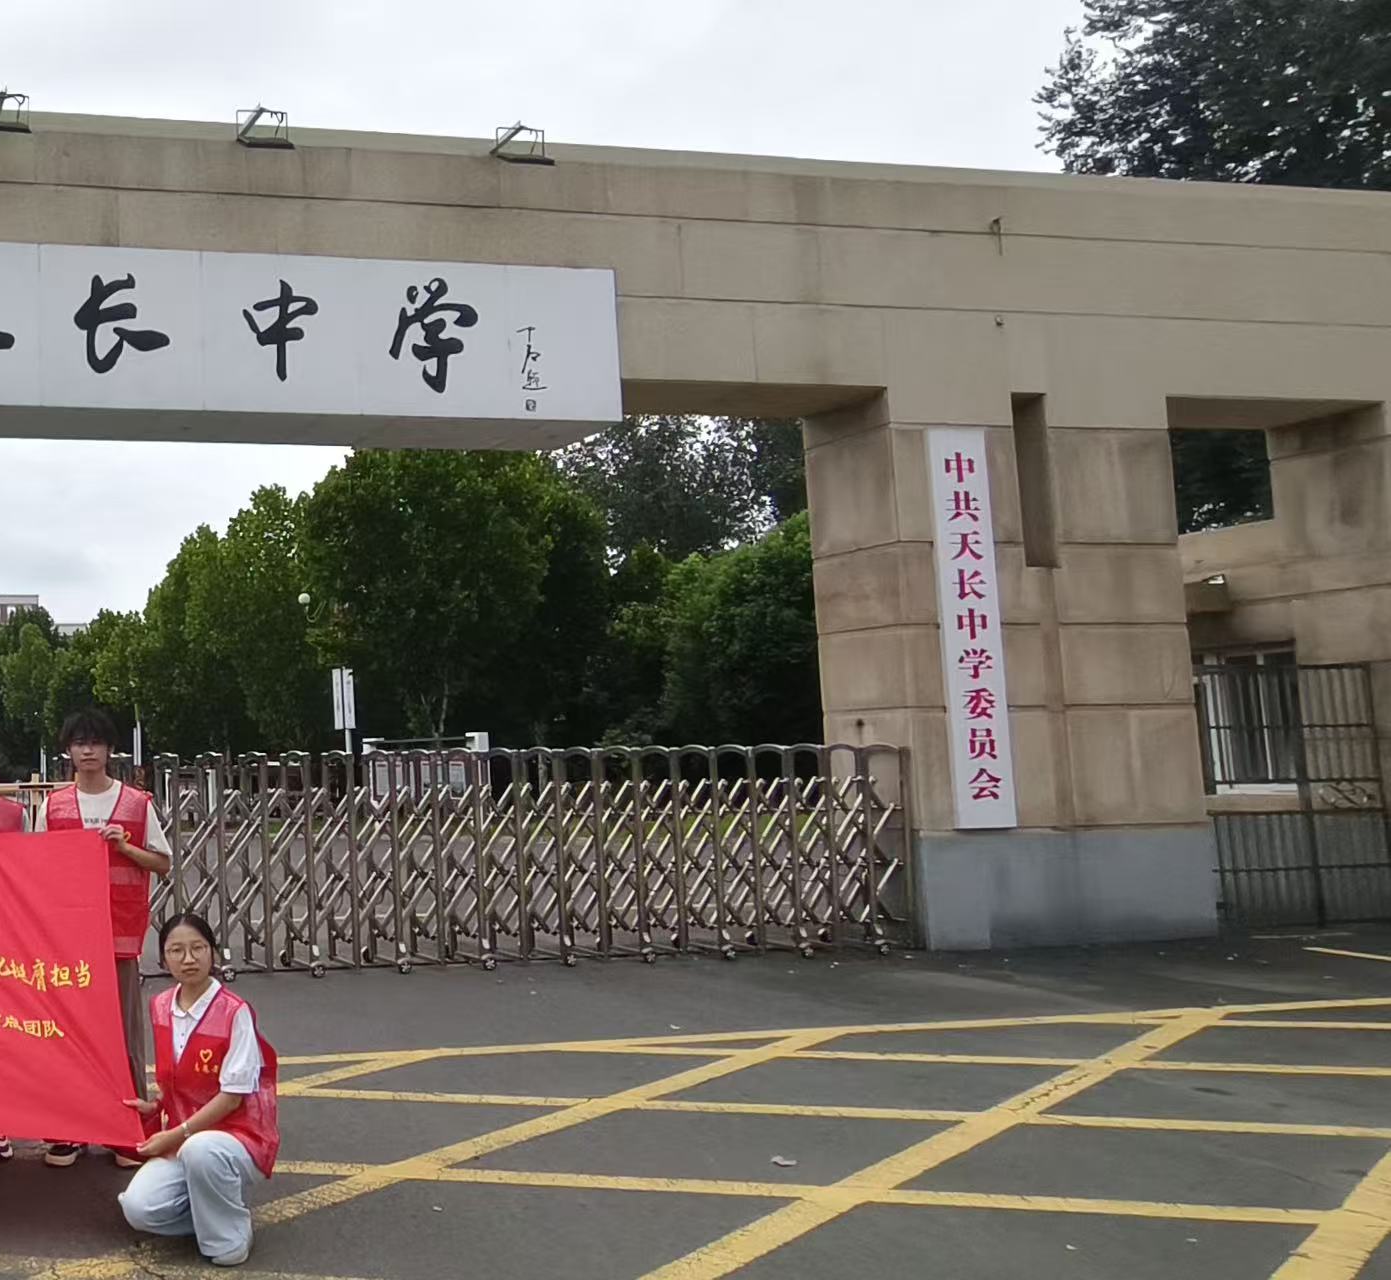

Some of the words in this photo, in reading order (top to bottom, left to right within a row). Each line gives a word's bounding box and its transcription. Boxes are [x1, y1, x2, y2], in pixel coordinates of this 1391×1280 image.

[944, 452, 1002, 800] 中共天长中学委员会
